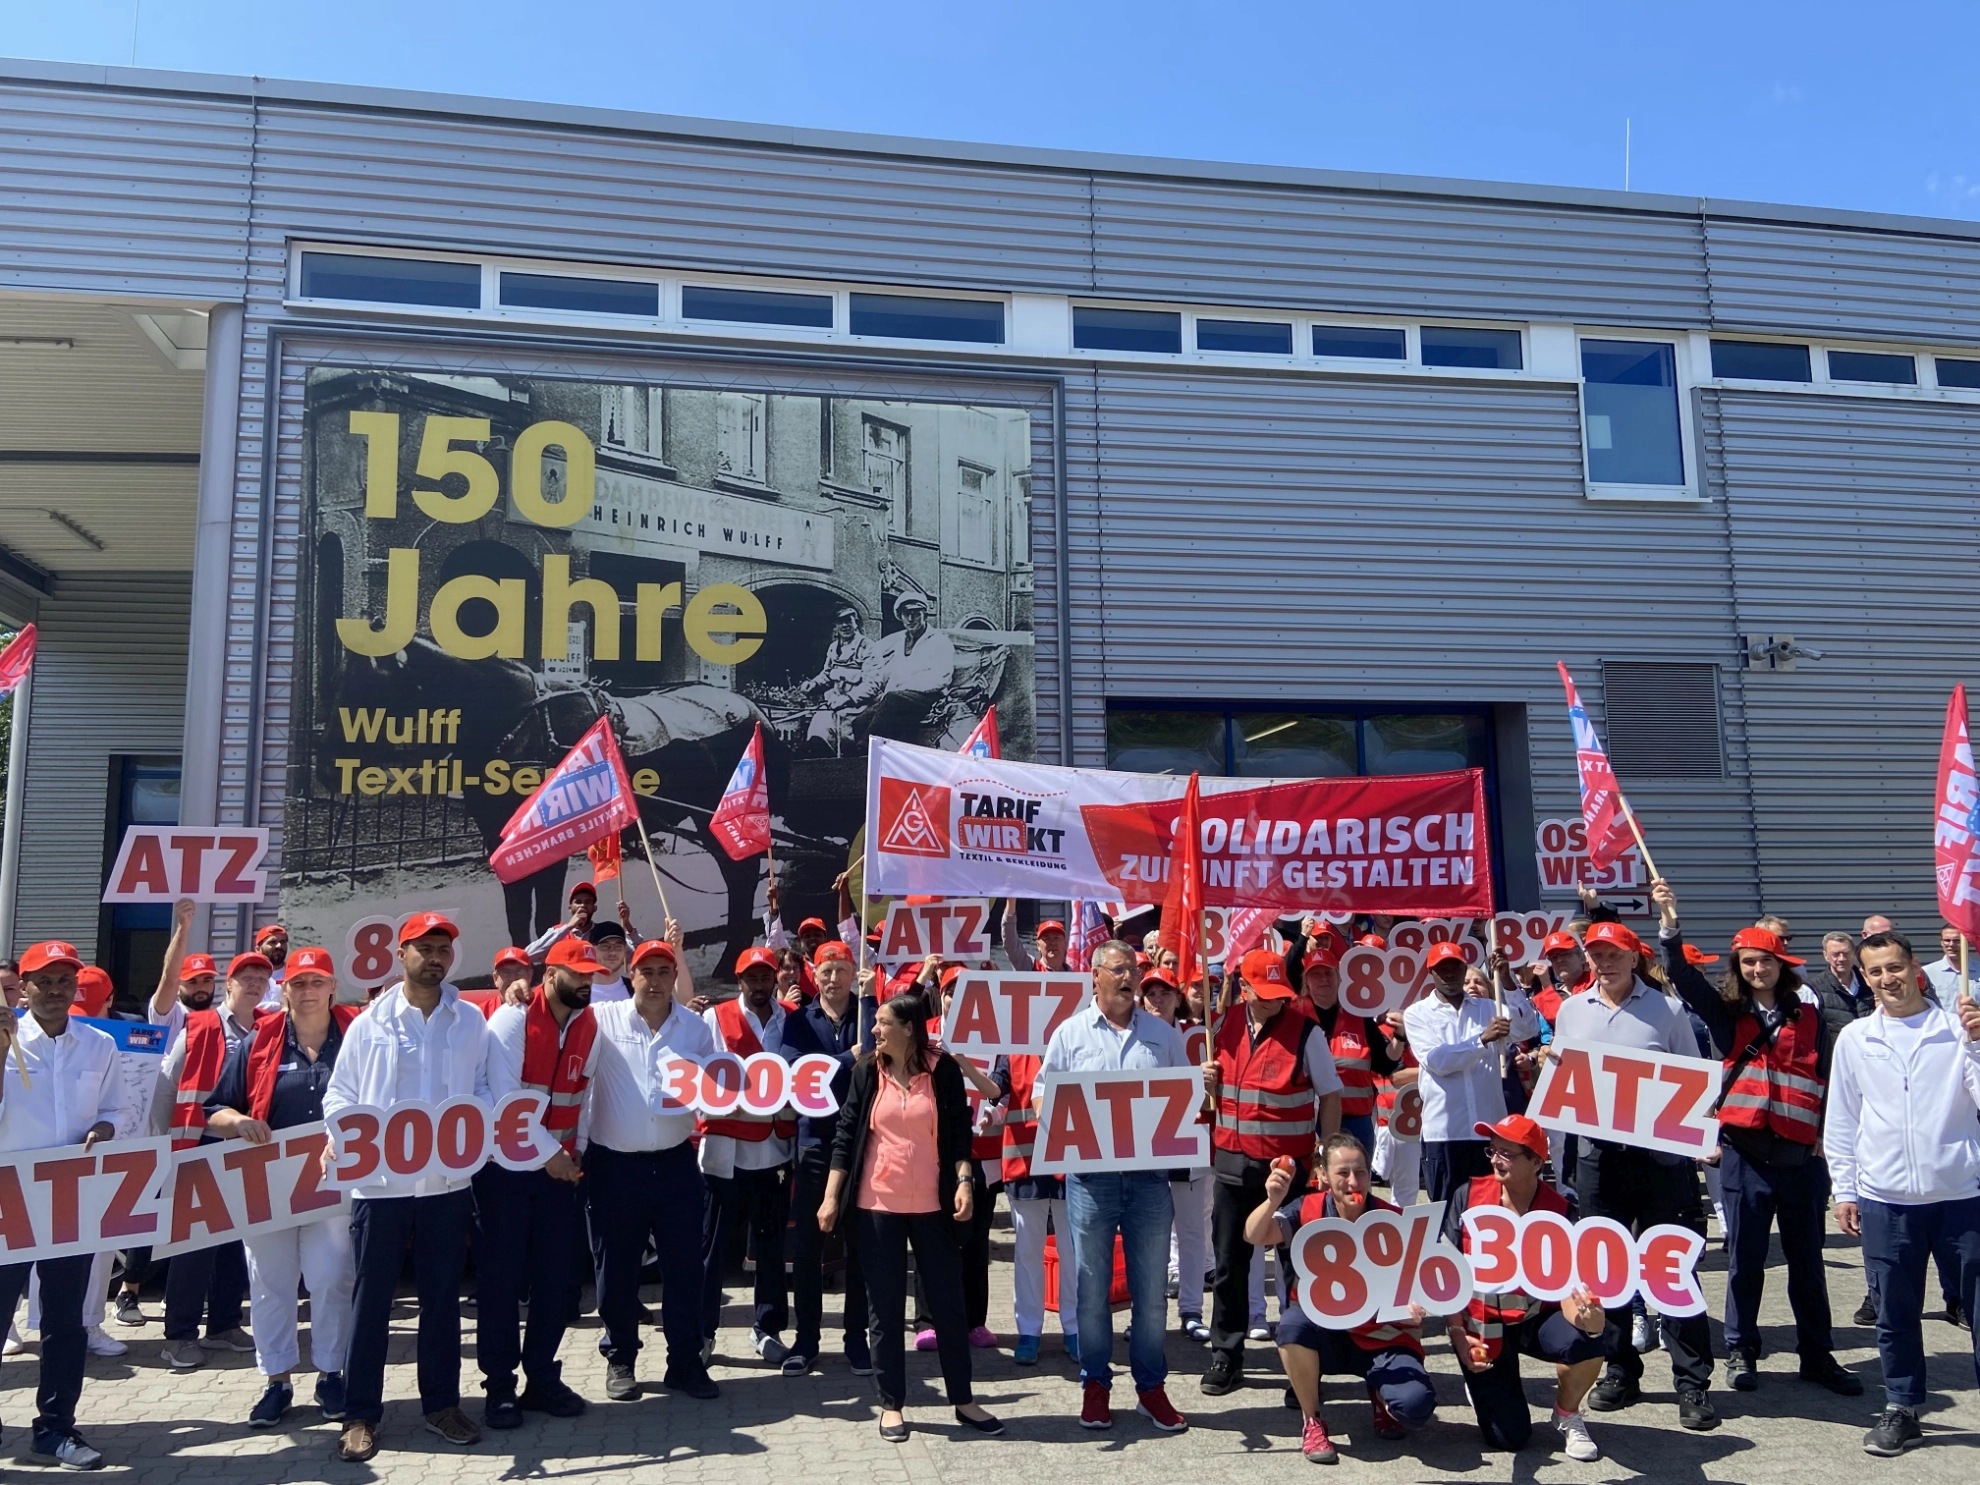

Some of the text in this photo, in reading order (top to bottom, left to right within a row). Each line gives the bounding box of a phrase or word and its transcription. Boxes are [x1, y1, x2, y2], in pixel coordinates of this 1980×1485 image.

[349, 411, 595, 527] 150
[593, 504, 783, 549] HEINRICH WULFF
[336, 548, 767, 666] Jahre
[339, 707, 461, 744] Wulff
[335, 759, 660, 796] Textil-See
[960, 792, 1042, 824] TARIF
[117, 835, 258, 894] ATZ
[960, 852, 992, 863] TEXTIL
[1005, 857, 1067, 871] BEKLEIDUNG
[1542, 823, 1588, 853] OS
[1119, 853, 1474, 889] ZUNFT GESTALTEN
[886, 907, 983, 955] ATZ
[951, 980, 1083, 1045] ATZ
[662, 1058, 831, 1110] 300€
[1539, 1048, 1709, 1146] ATZ
[337, 1098, 540, 1182] 300€
[1044, 1078, 1199, 1163] ATZ
[171, 1132, 341, 1245] ATZ
[1302, 1216, 1461, 1317] 8%
[1473, 1214, 1695, 1306] 300€
